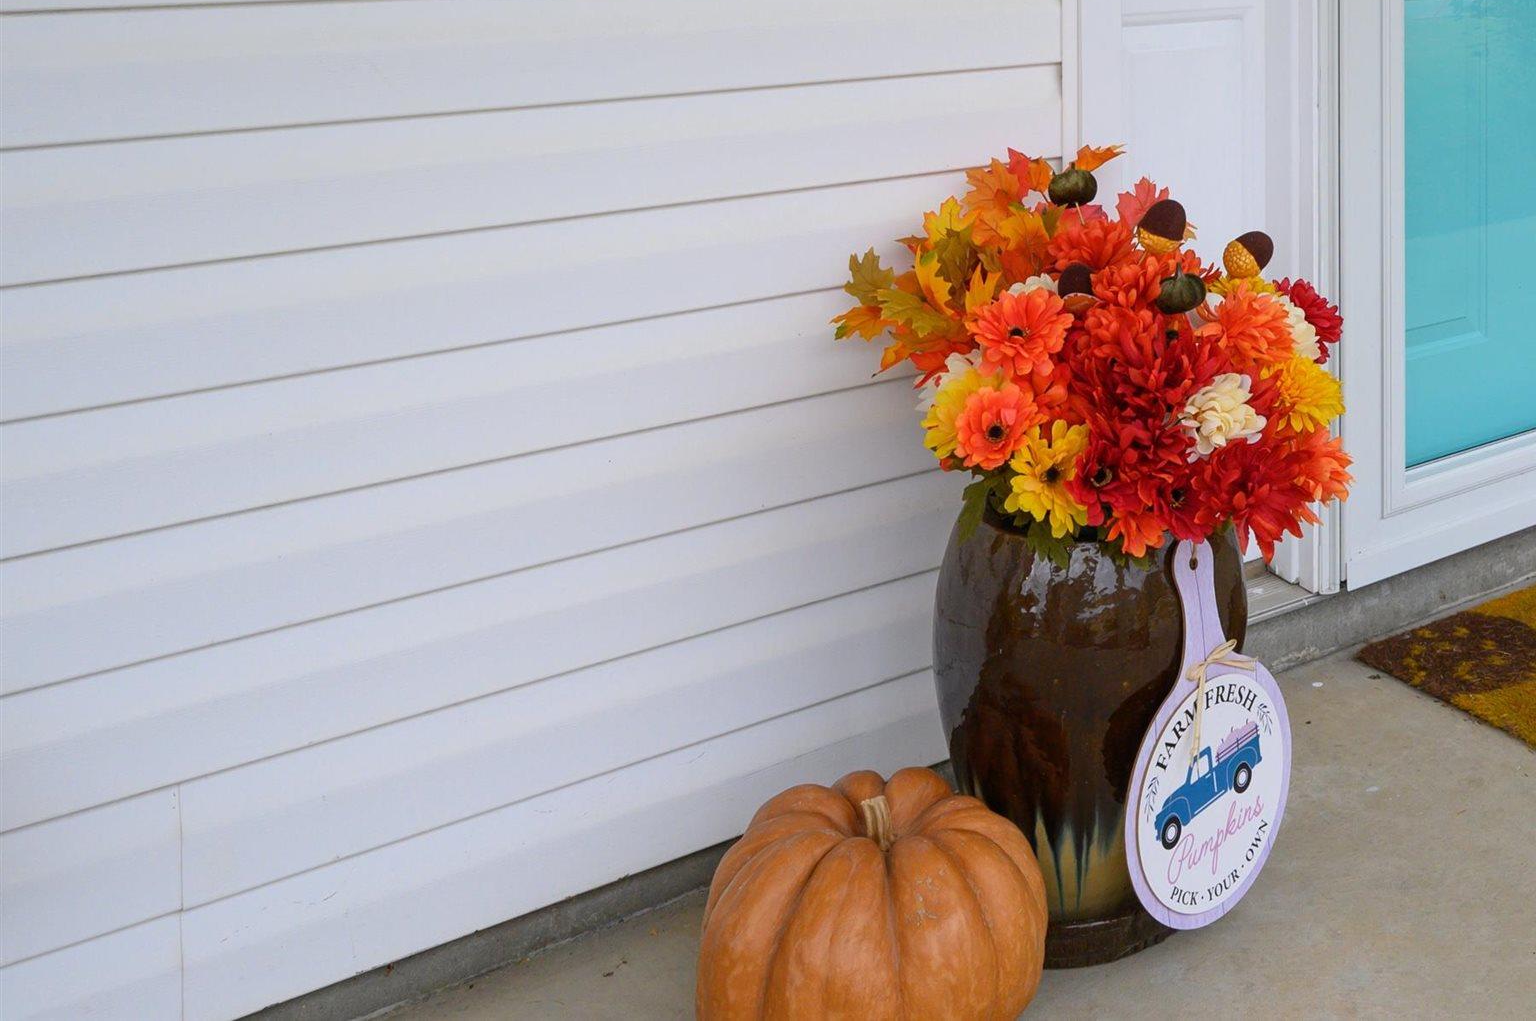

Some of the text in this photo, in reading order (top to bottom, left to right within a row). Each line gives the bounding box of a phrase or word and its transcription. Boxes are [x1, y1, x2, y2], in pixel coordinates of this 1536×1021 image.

[1155, 683, 1258, 770] FARM FRESH
[1167, 795, 1264, 885] Pumpkins
[1169, 819, 1269, 906] PICK YOUR OWN
